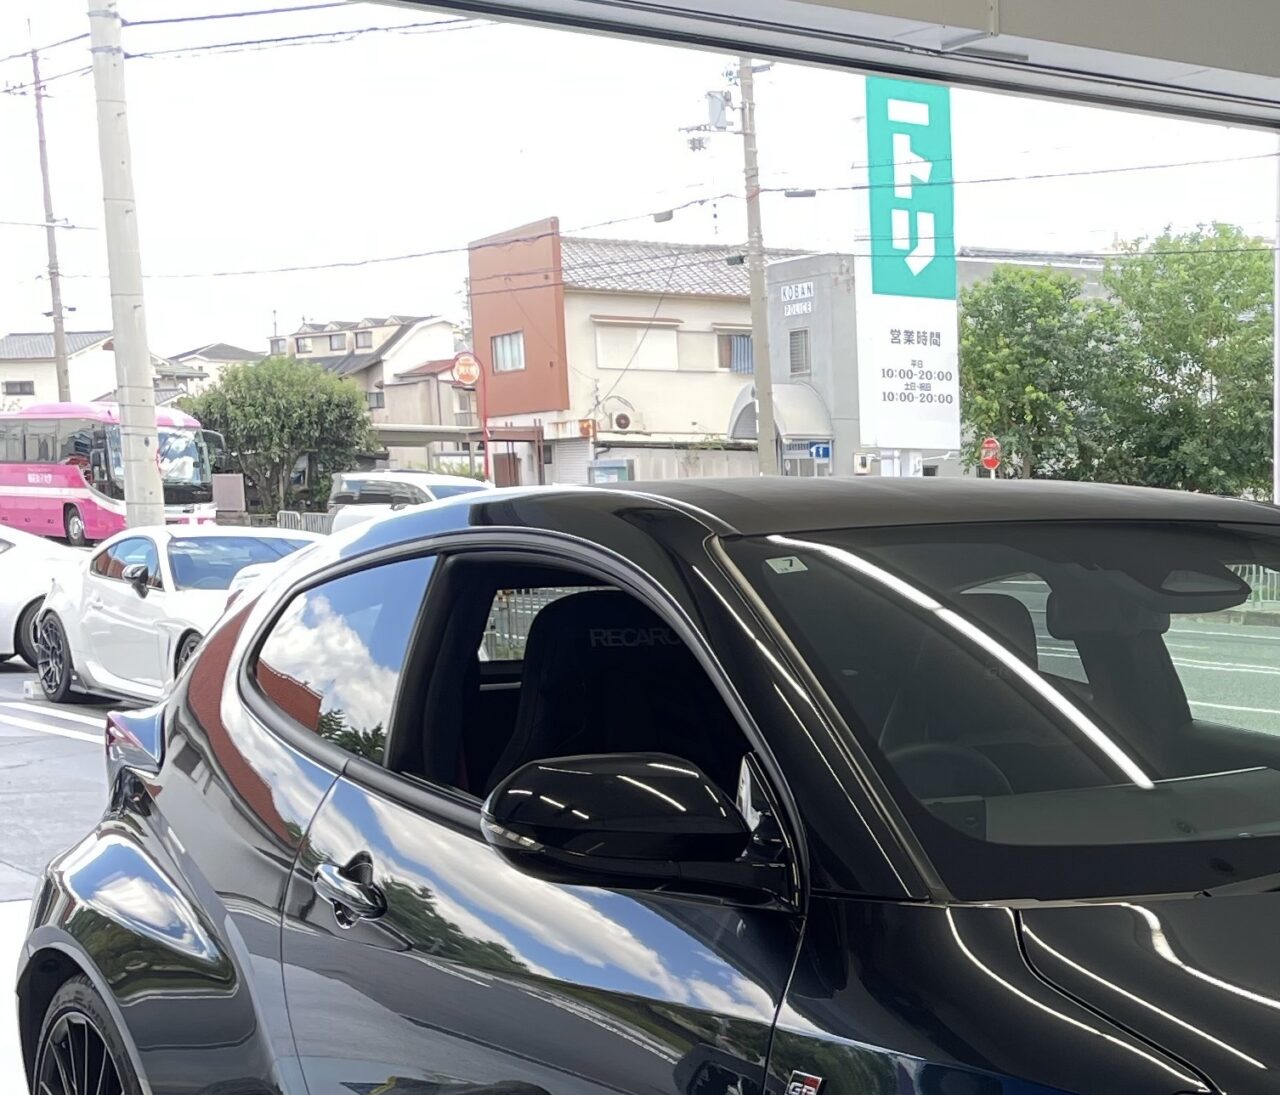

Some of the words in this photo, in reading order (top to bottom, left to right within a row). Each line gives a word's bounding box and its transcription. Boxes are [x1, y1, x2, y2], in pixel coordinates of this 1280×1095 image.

[782, 283, 812, 300] KOBAN
[890, 329, 941, 347] 営業時間
[911, 360, 923, 368] 平日
[881, 368, 953, 381] 10:00-20:00
[882, 392, 953, 404] 10:00-20:00
